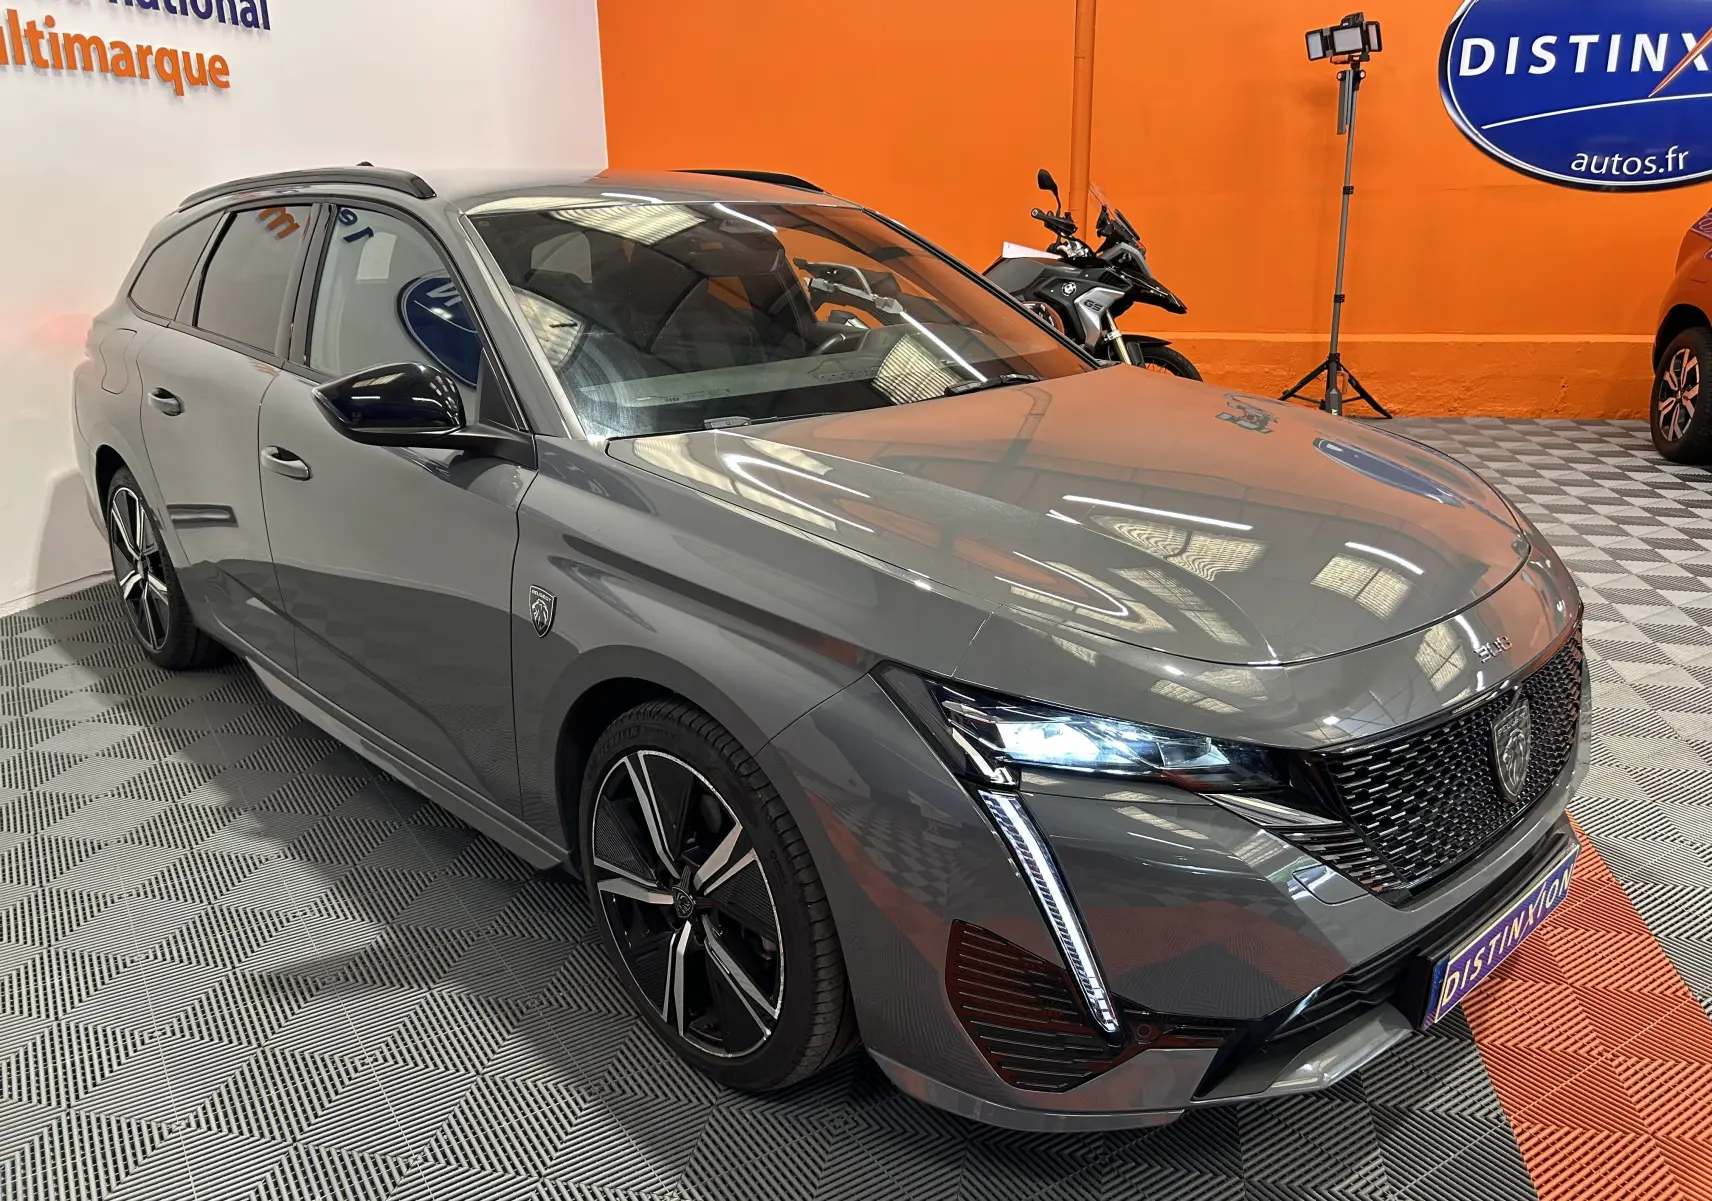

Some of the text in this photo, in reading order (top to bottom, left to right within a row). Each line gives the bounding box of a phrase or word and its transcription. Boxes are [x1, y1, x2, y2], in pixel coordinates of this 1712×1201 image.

[1570, 145, 1690, 176] autos.fr
[1083, 299, 1105, 312] GS
[1441, 863, 1574, 1008] DISTINXION
